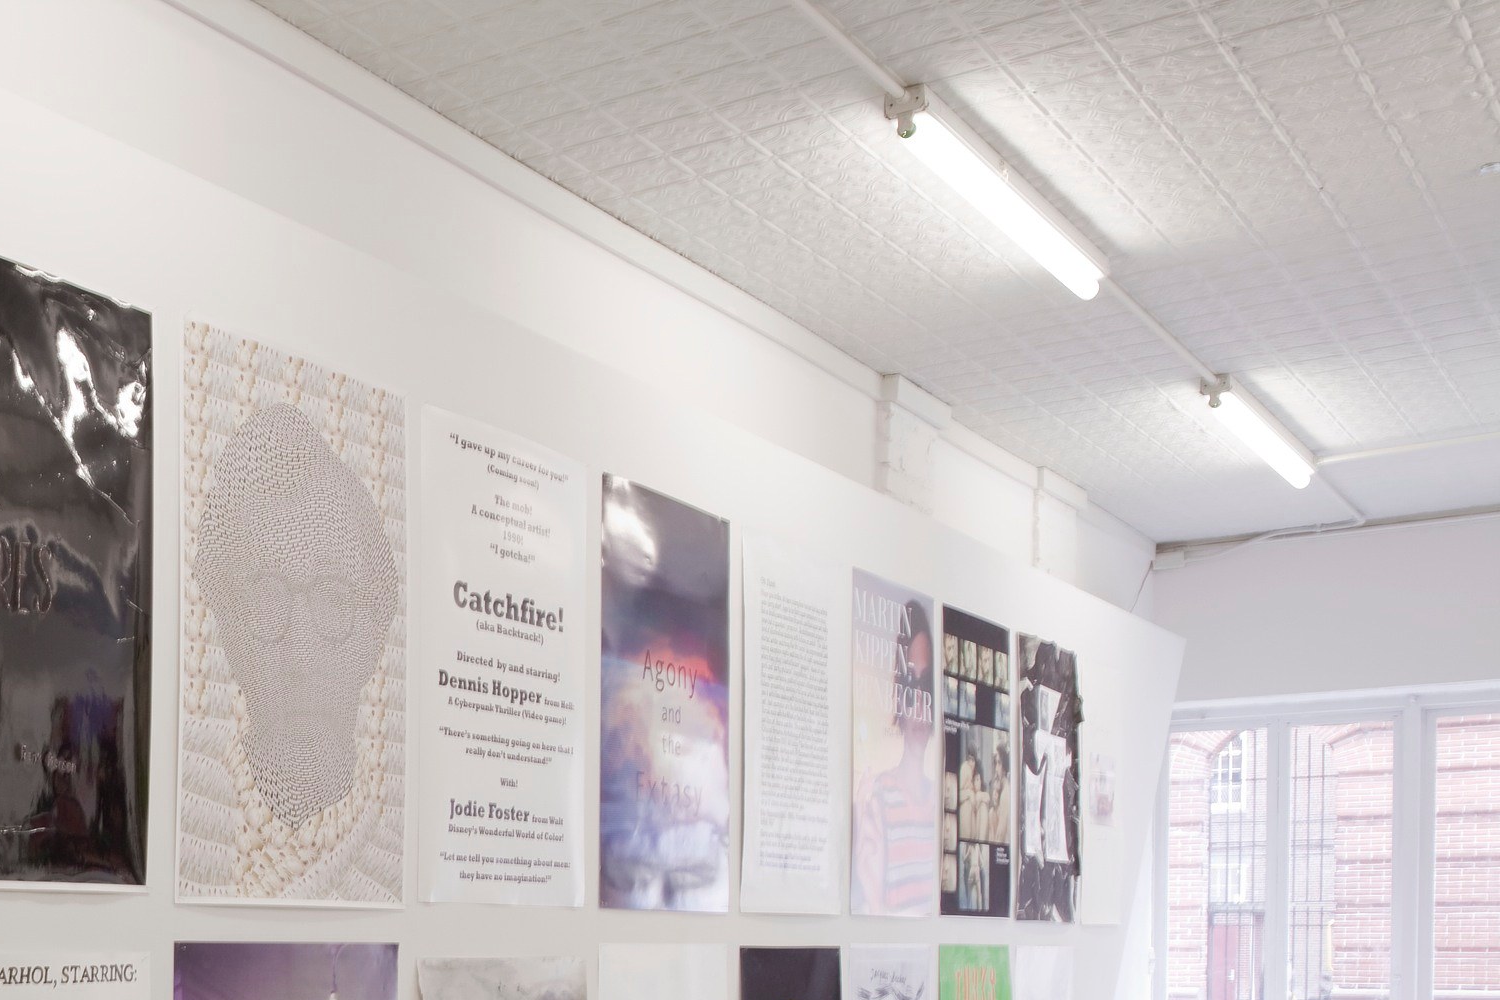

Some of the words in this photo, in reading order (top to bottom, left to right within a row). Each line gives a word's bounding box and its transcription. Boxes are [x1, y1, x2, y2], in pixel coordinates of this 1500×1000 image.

[461, 438, 482, 452] gave
[485, 445, 496, 458] up
[498, 451, 510, 464] my
[512, 455, 537, 472] career
[538, 464, 549, 475] for
[471, 504, 478, 514] A
[479, 509, 526, 530] conceptual
[453, 580, 564, 632] Catchfire!
[855, 587, 912, 639] MARTIN
[457, 650, 493, 667] Directed
[497, 659, 506, 672] by
[509, 662, 524, 674] and
[526, 666, 561, 683] starring!
[856, 630, 908, 676] KIPPEN
[438, 669, 488, 694] Dennis
[492, 679, 542, 705] Hopper
[642, 649, 698, 698] Agony
[661, 705, 681, 724] and
[661, 735, 680, 755] the
[450, 799, 485, 819] Jodie
[488, 802, 530, 822] Foster
[61, 964, 137, 983] STARRING:
